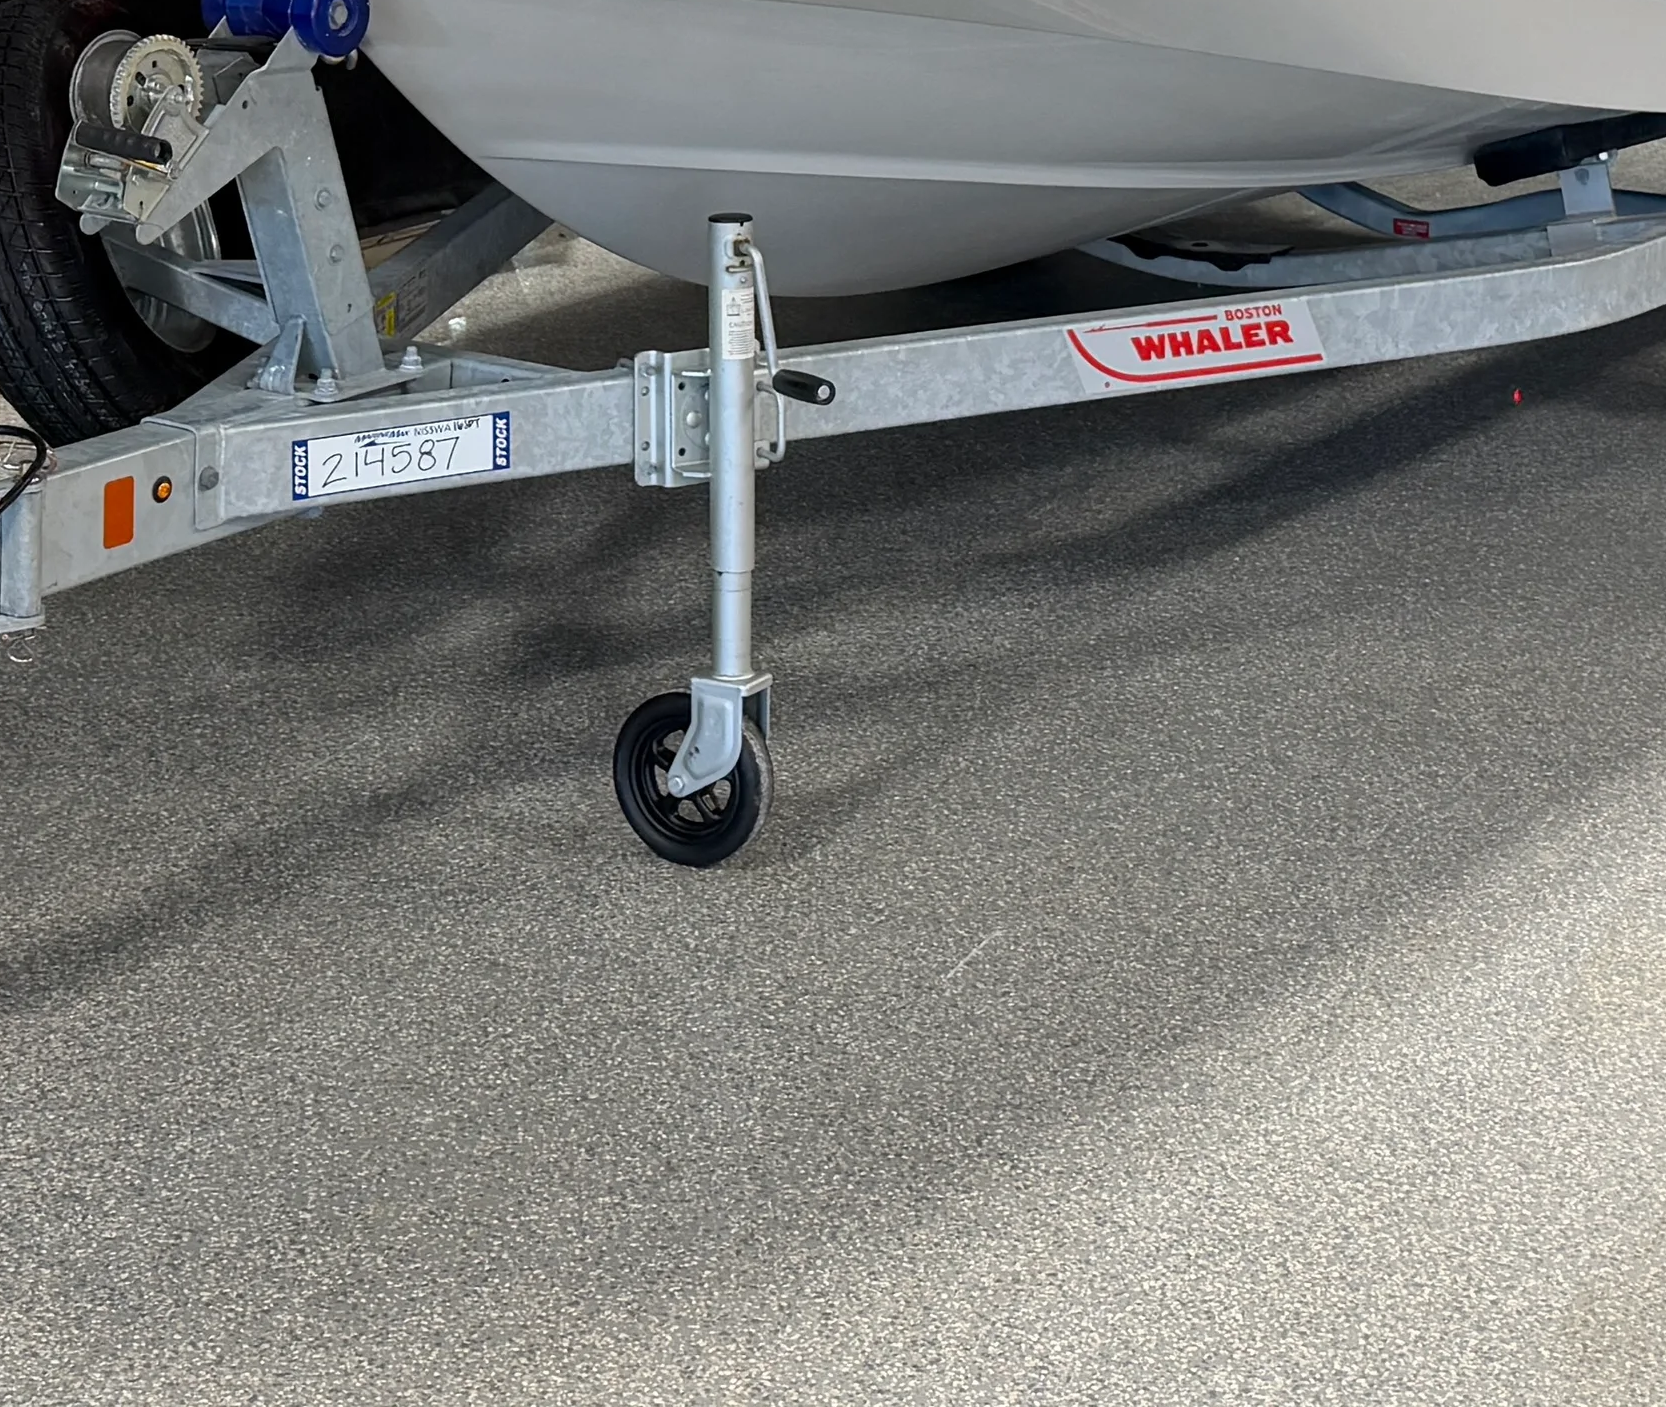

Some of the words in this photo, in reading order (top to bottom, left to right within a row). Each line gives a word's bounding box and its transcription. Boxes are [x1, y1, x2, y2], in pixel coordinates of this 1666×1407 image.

[1224, 303, 1283, 322] BOSTON
[1131, 319, 1294, 362] WHALER
[321, 435, 461, 488] 214587
[495, 417, 509, 467] STOCK
[294, 444, 308, 496] STOCK
